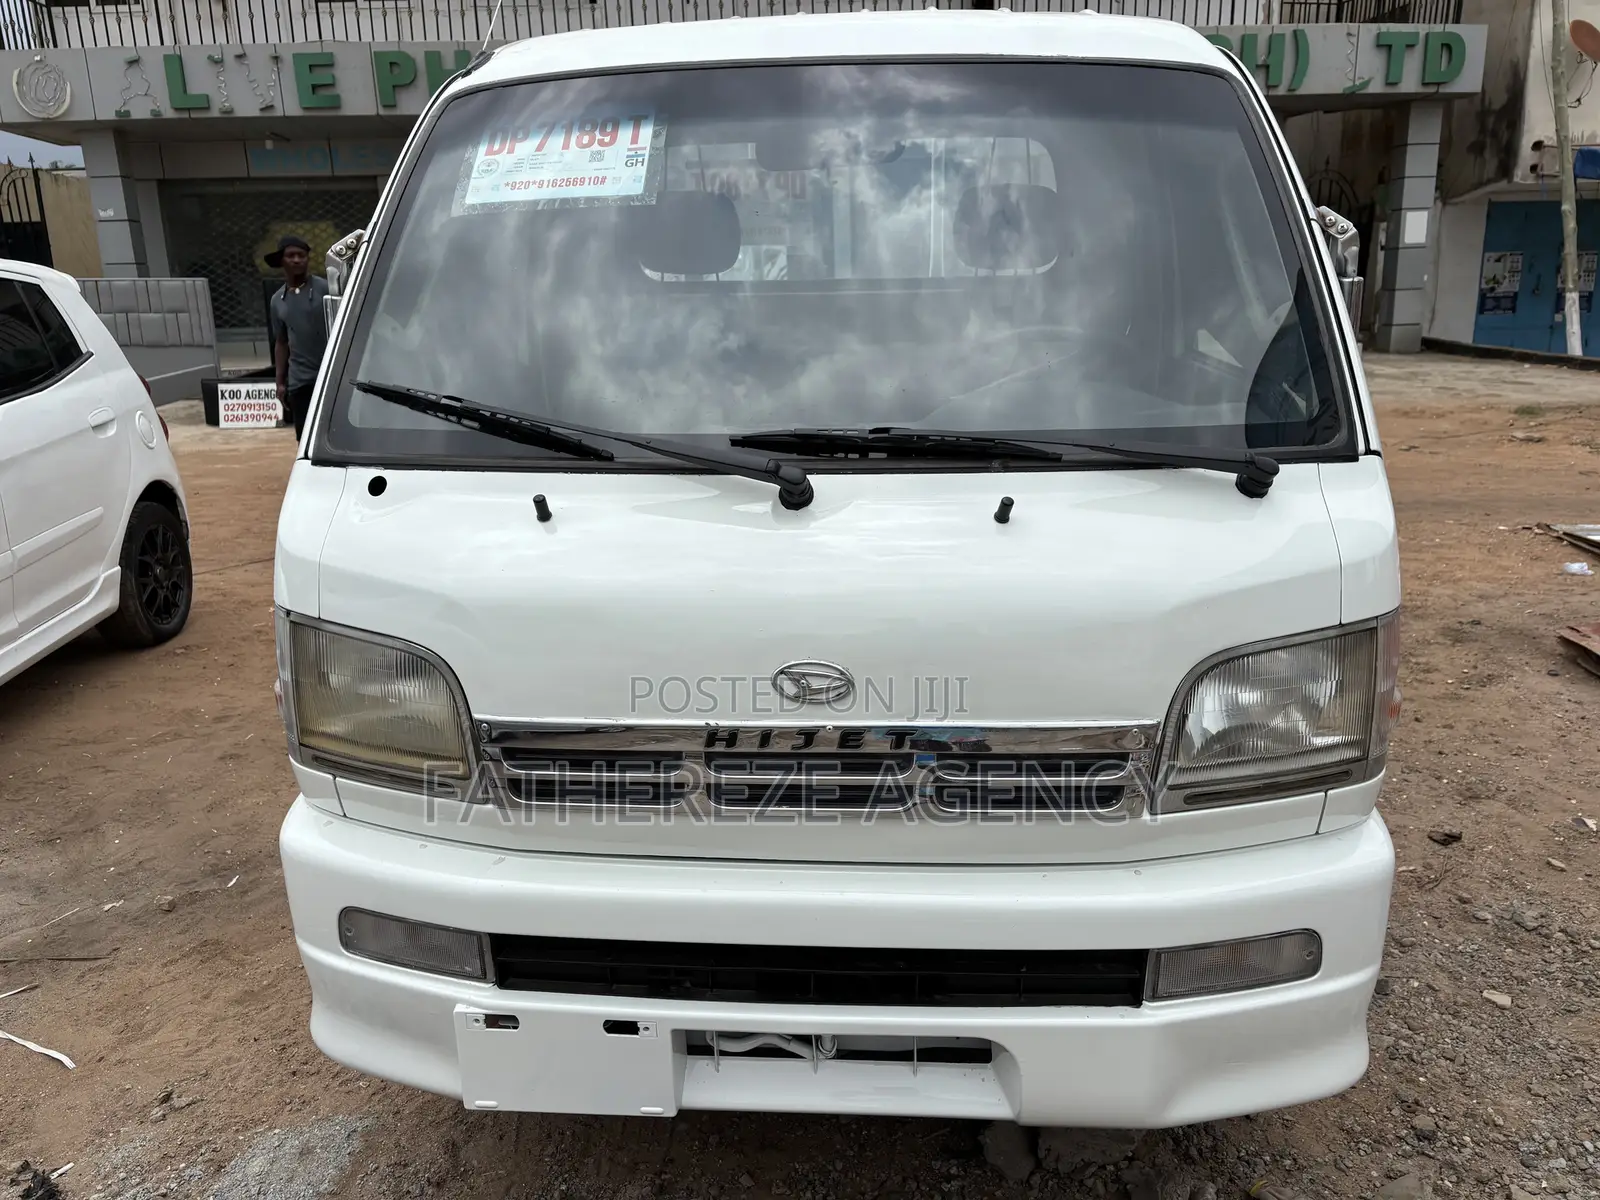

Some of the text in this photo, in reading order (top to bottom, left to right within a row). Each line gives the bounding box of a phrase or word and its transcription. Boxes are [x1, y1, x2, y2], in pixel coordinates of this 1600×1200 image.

[484, 114, 649, 156] DP 7189 T
[625, 158, 645, 168] GH
[220, 389, 242, 400] KOO
[223, 402, 277, 412] 0270913150
[703, 728, 918, 751] HIJET
